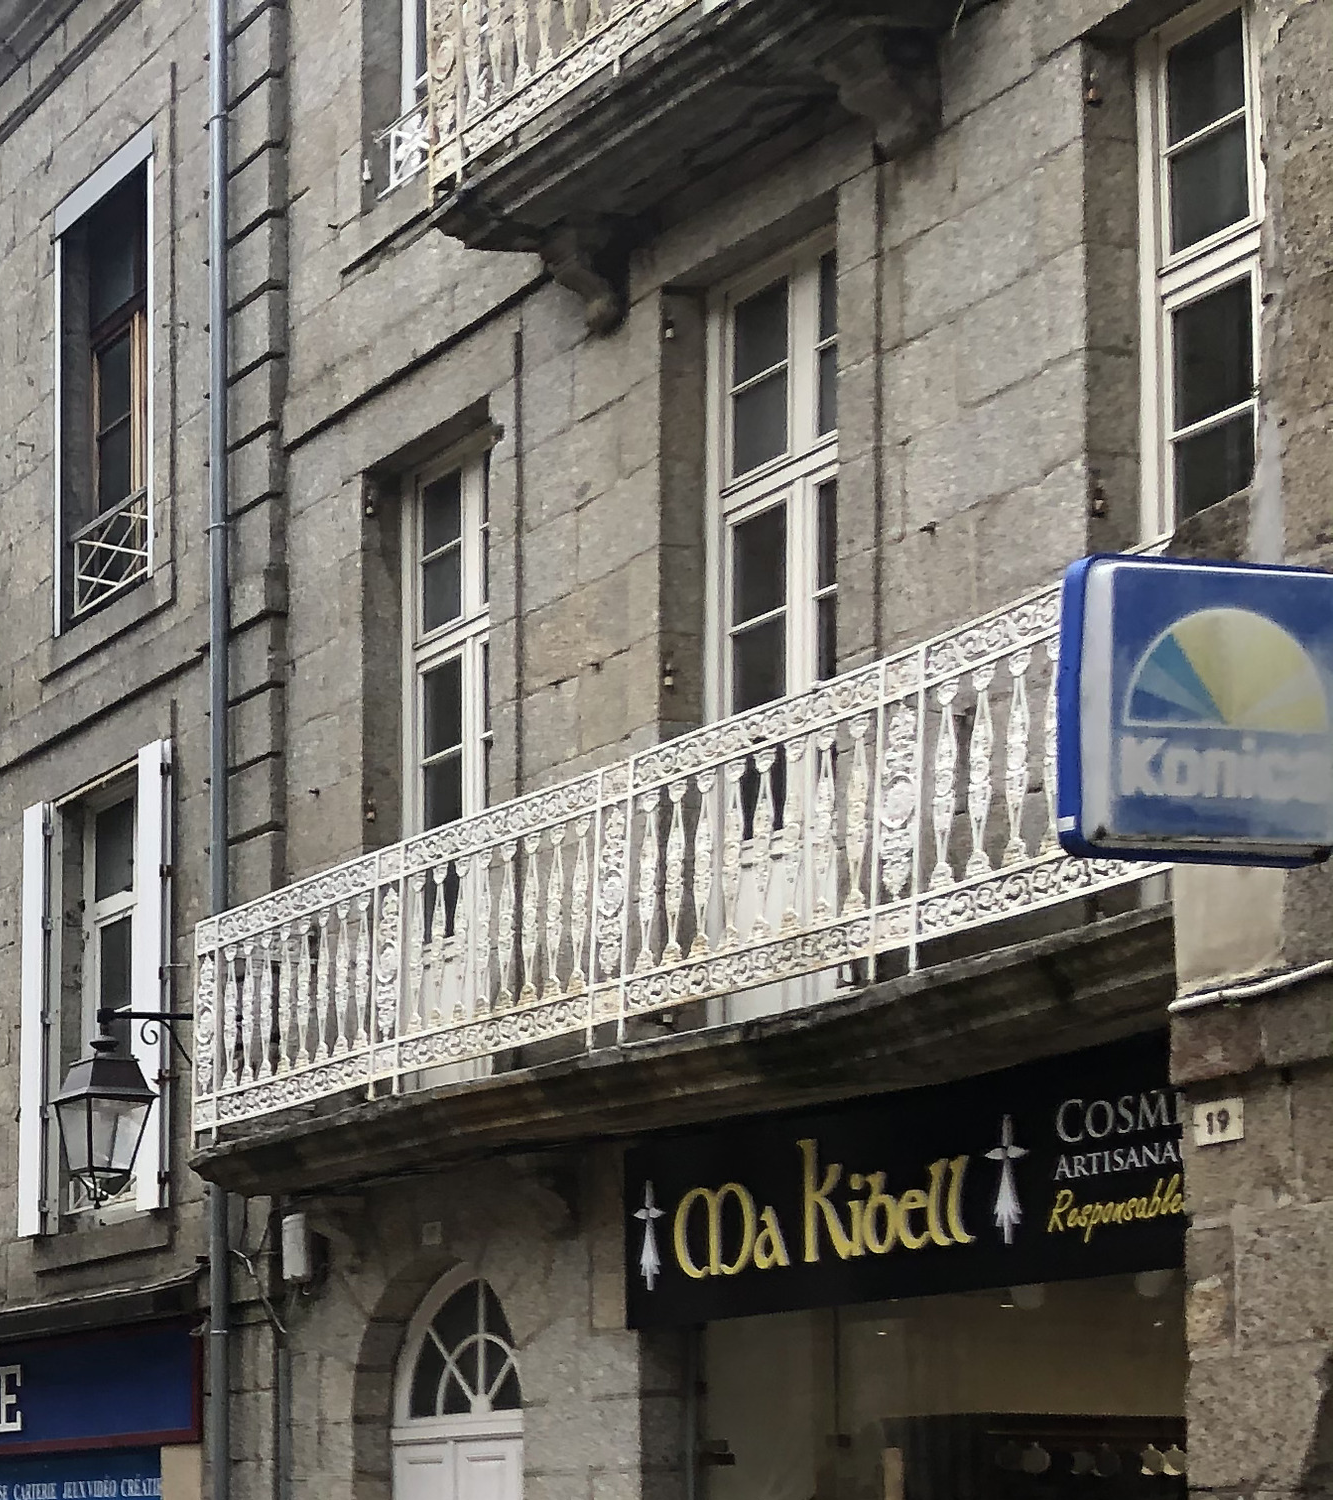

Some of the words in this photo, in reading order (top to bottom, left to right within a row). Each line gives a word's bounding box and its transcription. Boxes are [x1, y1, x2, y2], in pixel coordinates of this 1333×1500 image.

[1205, 1107, 1231, 1136] 19
[1052, 1138, 1183, 1181] ARTISANA
[673, 1182, 791, 1279] Ma
[796, 1138, 978, 1262] Kibell
[13, 1483, 57, 1500] CARTERIE
